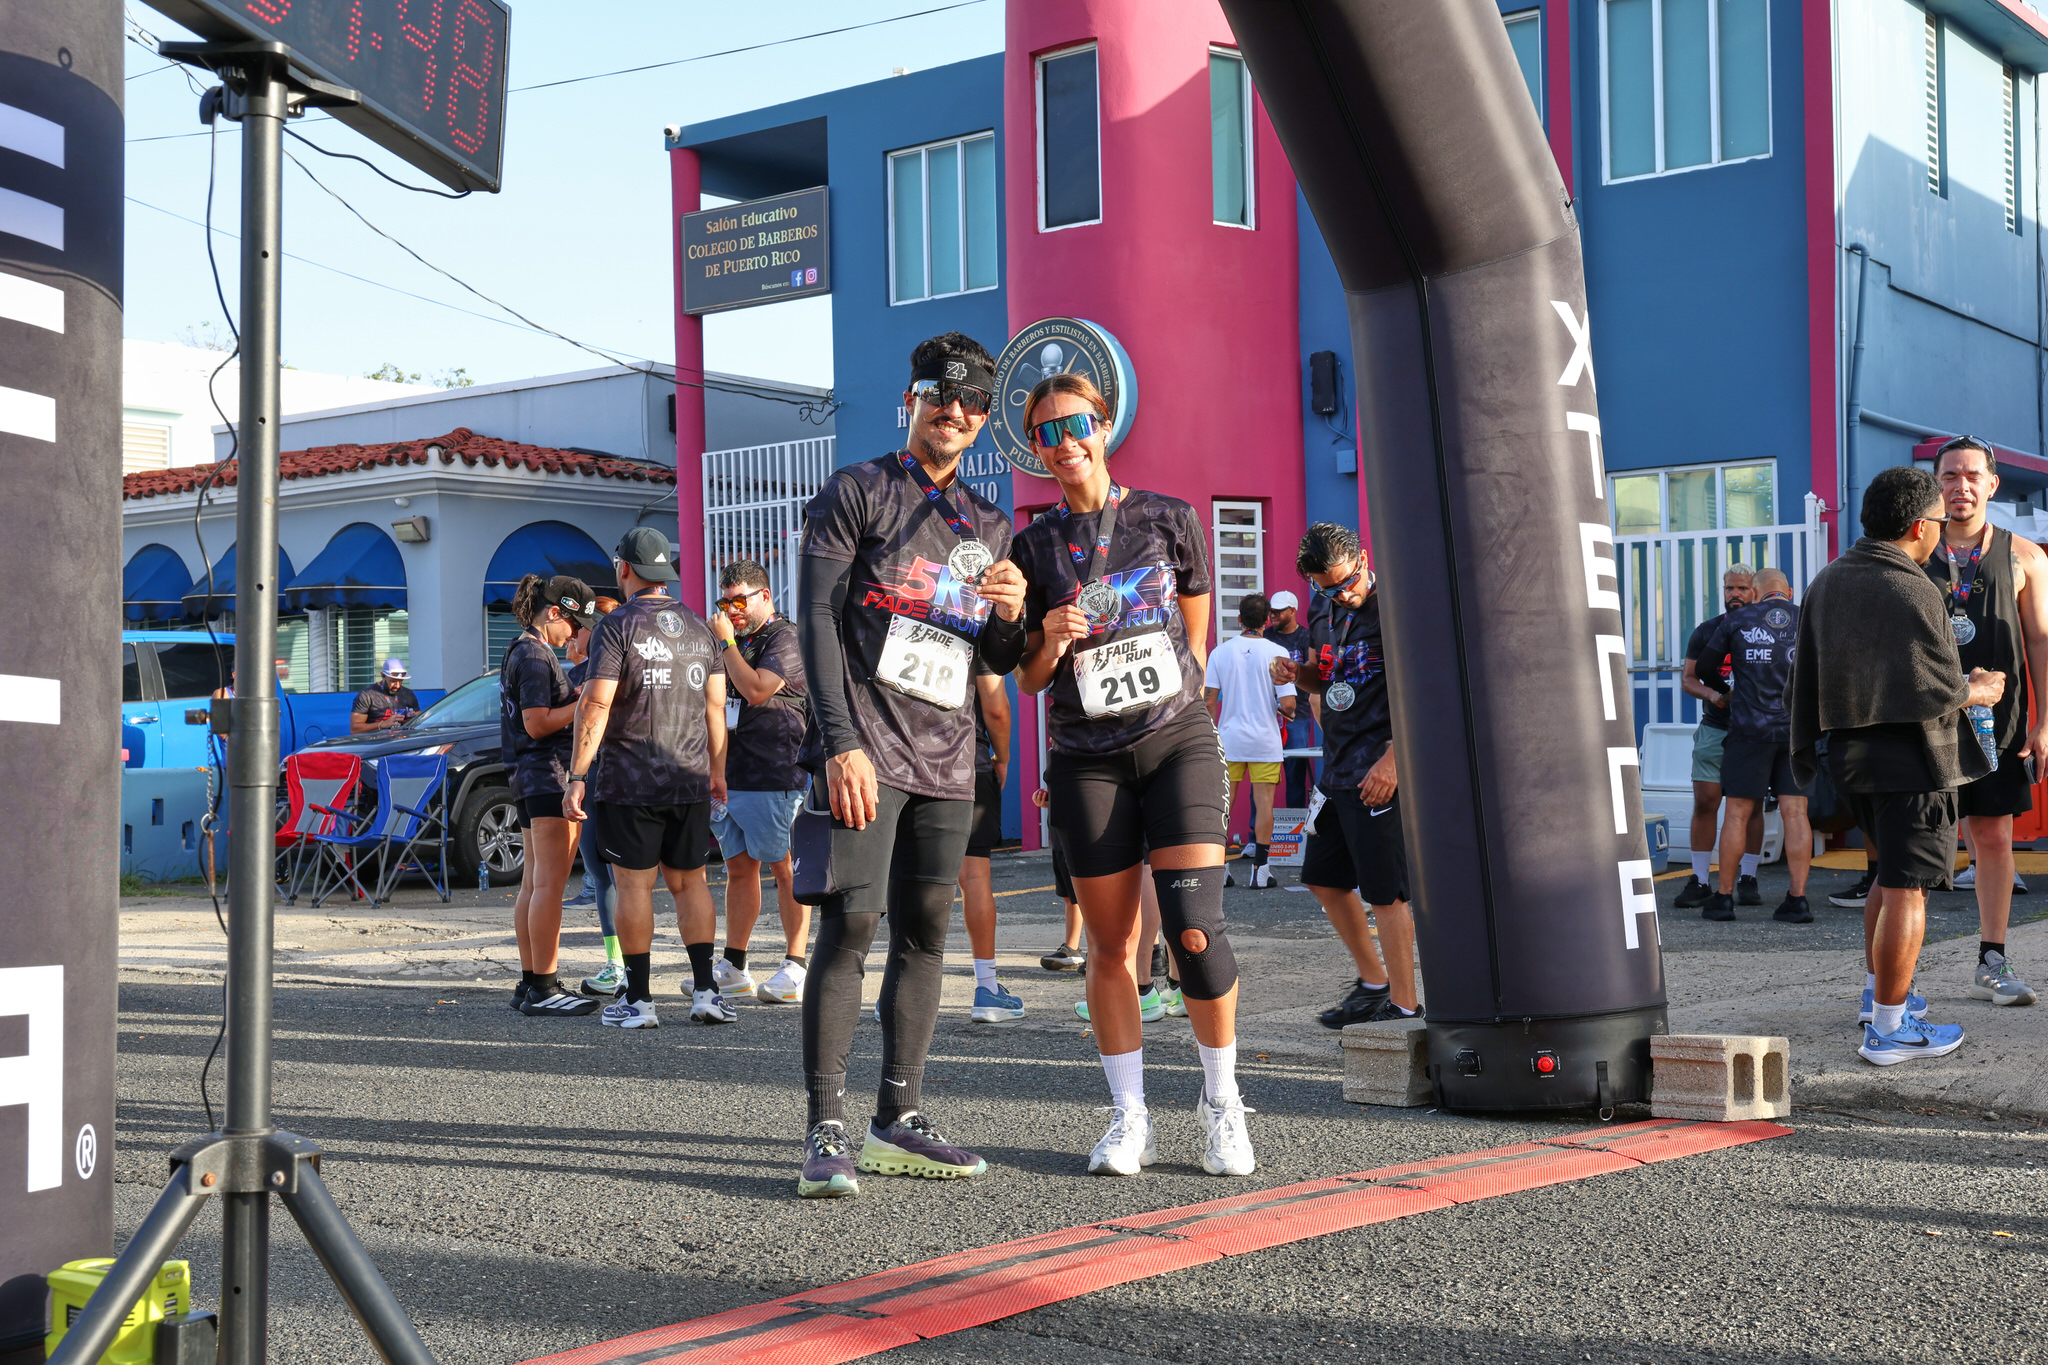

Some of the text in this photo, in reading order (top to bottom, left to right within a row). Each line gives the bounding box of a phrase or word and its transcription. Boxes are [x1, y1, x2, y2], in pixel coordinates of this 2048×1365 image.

[706, 206, 798, 234] Salón Educativo
[688, 224, 818, 260] COLEGIO DE BARBEROS
[705, 249, 800, 278] DE PUERTO RICO
[991, 324, 1113, 412] COLEGIO DE BARBEROS Y ESTILISTAS EN BARBERÍA
[896, 555, 964, 607] 5K
[862, 590, 931, 619] FADE
[929, 607, 945, 624] &
[1126, 606, 1172, 628] RUN
[922, 627, 954, 648] FADE
[1106, 640, 1138, 659] FADE
[1116, 648, 1152, 665] & RUN
[1746, 649, 1772, 660] EME
[643, 669, 671, 684] EME
[898, 652, 954, 693] 218
[1100, 666, 1160, 707] 219
